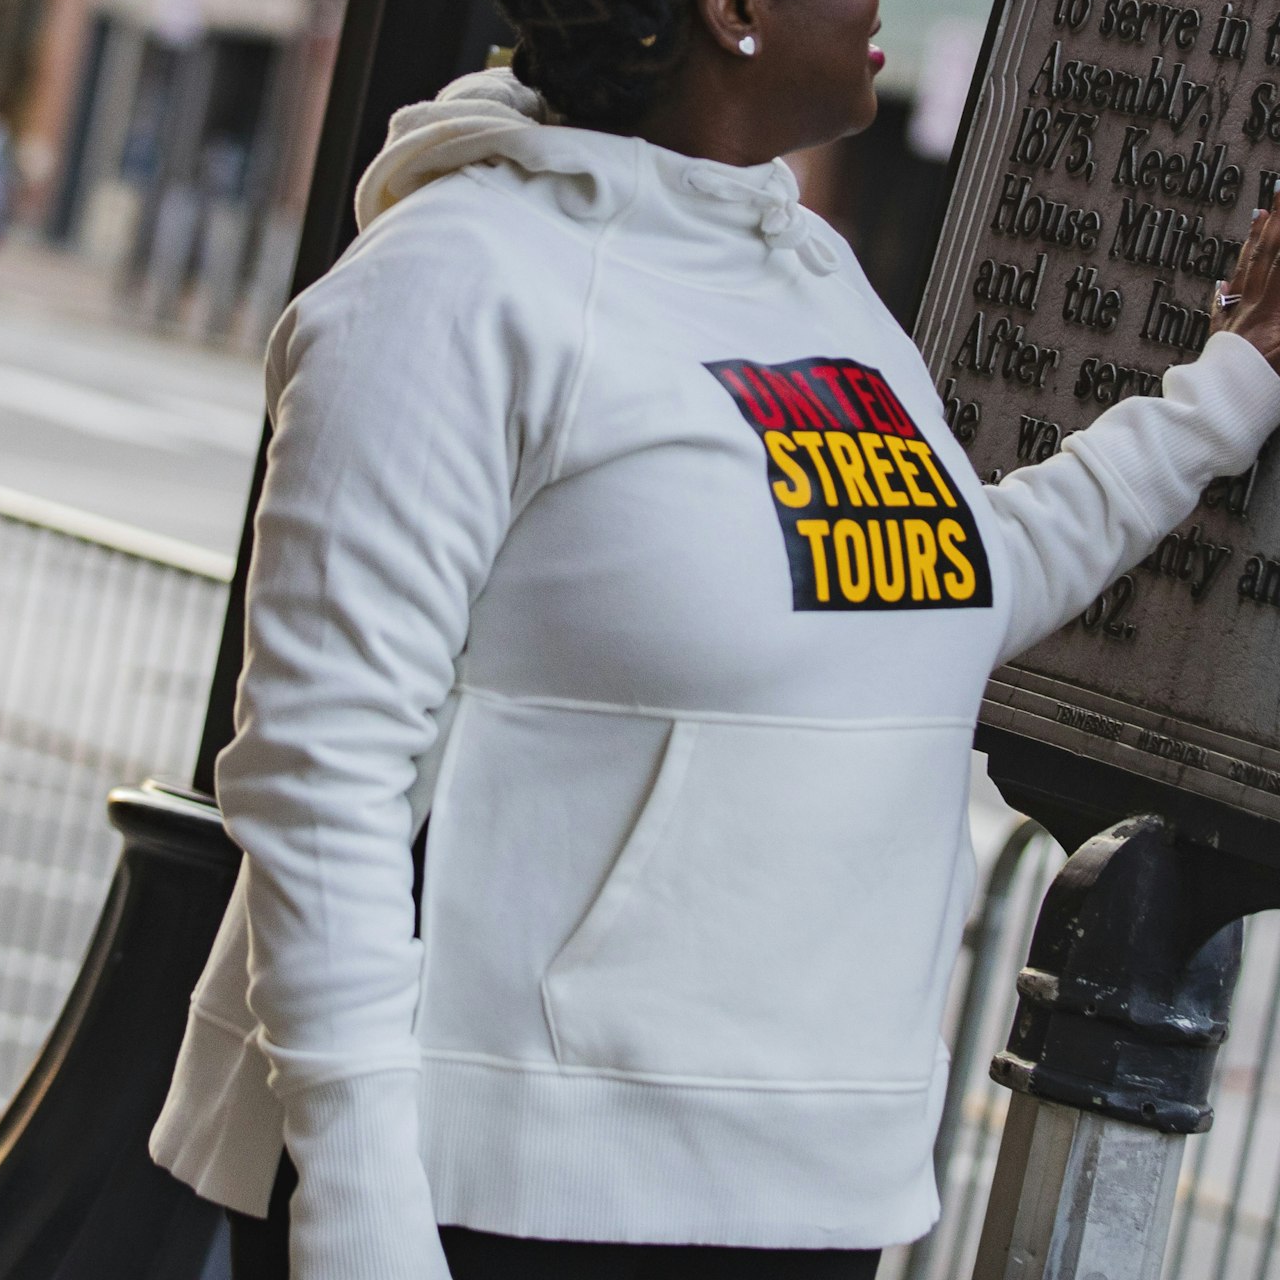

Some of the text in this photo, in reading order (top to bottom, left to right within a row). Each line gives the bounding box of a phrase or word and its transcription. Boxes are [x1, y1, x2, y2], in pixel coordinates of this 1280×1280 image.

[1209, 2, 1253, 61] in
[1028, 40, 1210, 133] Assembly.
[1009, 105, 1100, 184] 1875,
[1111, 125, 1244, 209] Keeble
[989, 171, 1102, 250] House
[1108, 195, 1244, 282] Militar
[972, 251, 1048, 312] and
[1062, 263, 1121, 331] the
[950, 310, 1061, 390] After
[722, 364, 917, 439] UNITED
[1017, 413, 1083, 464] wa
[763, 430, 959, 509] STREET
[795, 517, 976, 604] TOURS
[1056, 700, 1125, 743] TENNESSEE
[1136, 726, 1210, 771] HISTORICAL
